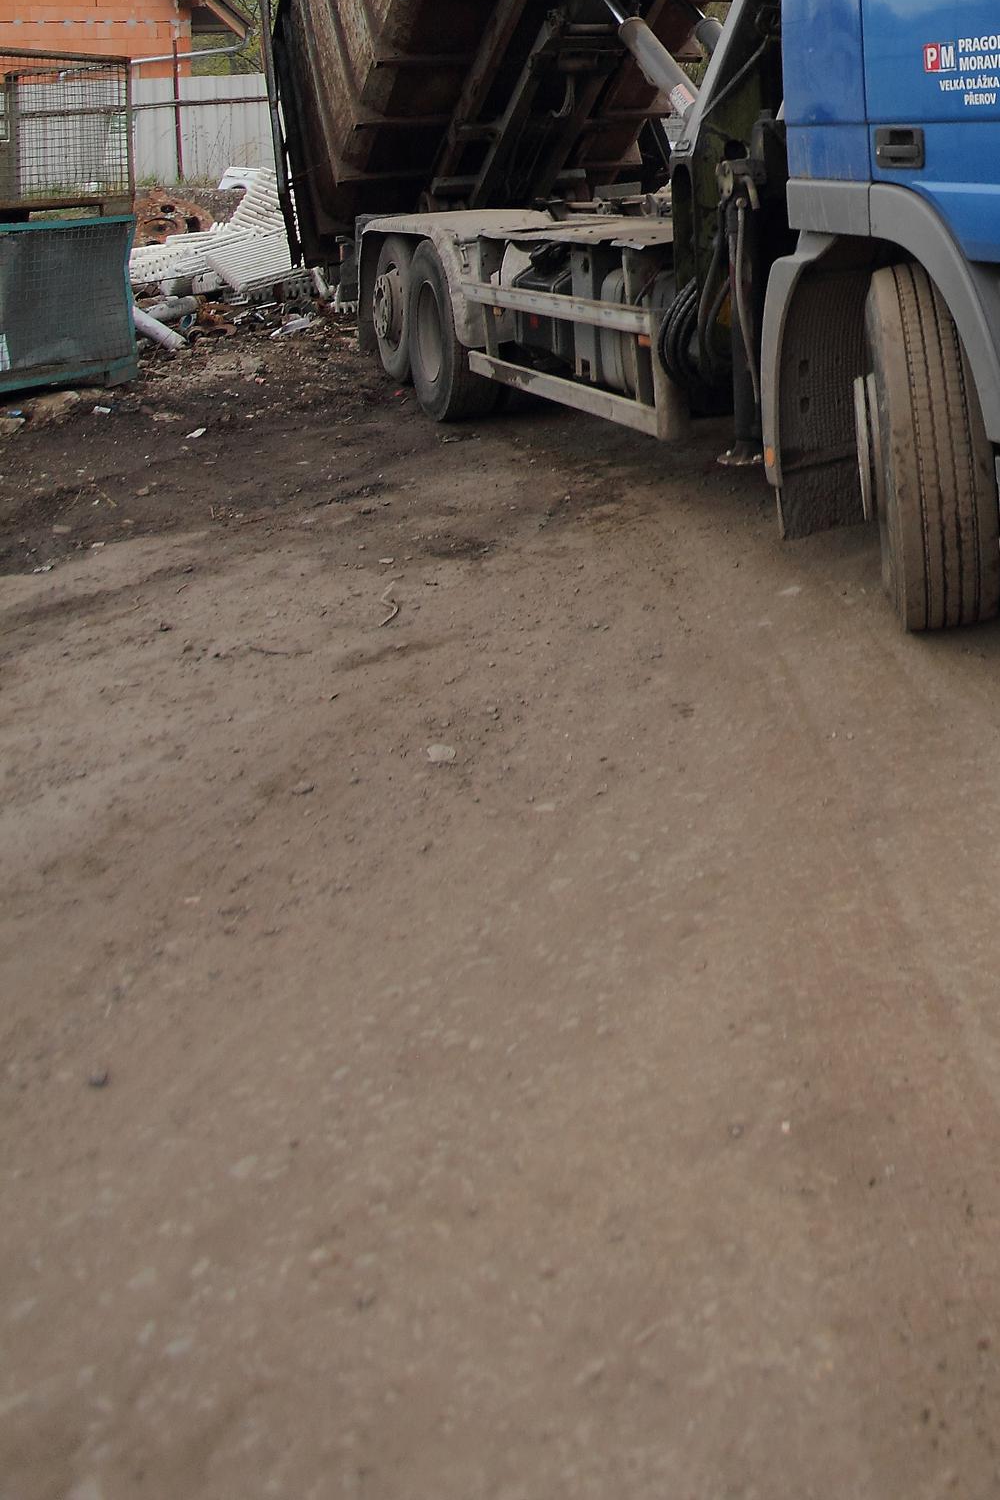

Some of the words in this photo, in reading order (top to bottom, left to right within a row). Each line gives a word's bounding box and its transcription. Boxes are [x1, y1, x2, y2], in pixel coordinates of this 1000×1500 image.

[926, 45, 955, 69] PM
[939, 76, 965, 91] VELKÁ
[966, 74, 1000, 90] DLÁŽKA
[964, 91, 997, 106] PŘEROV
